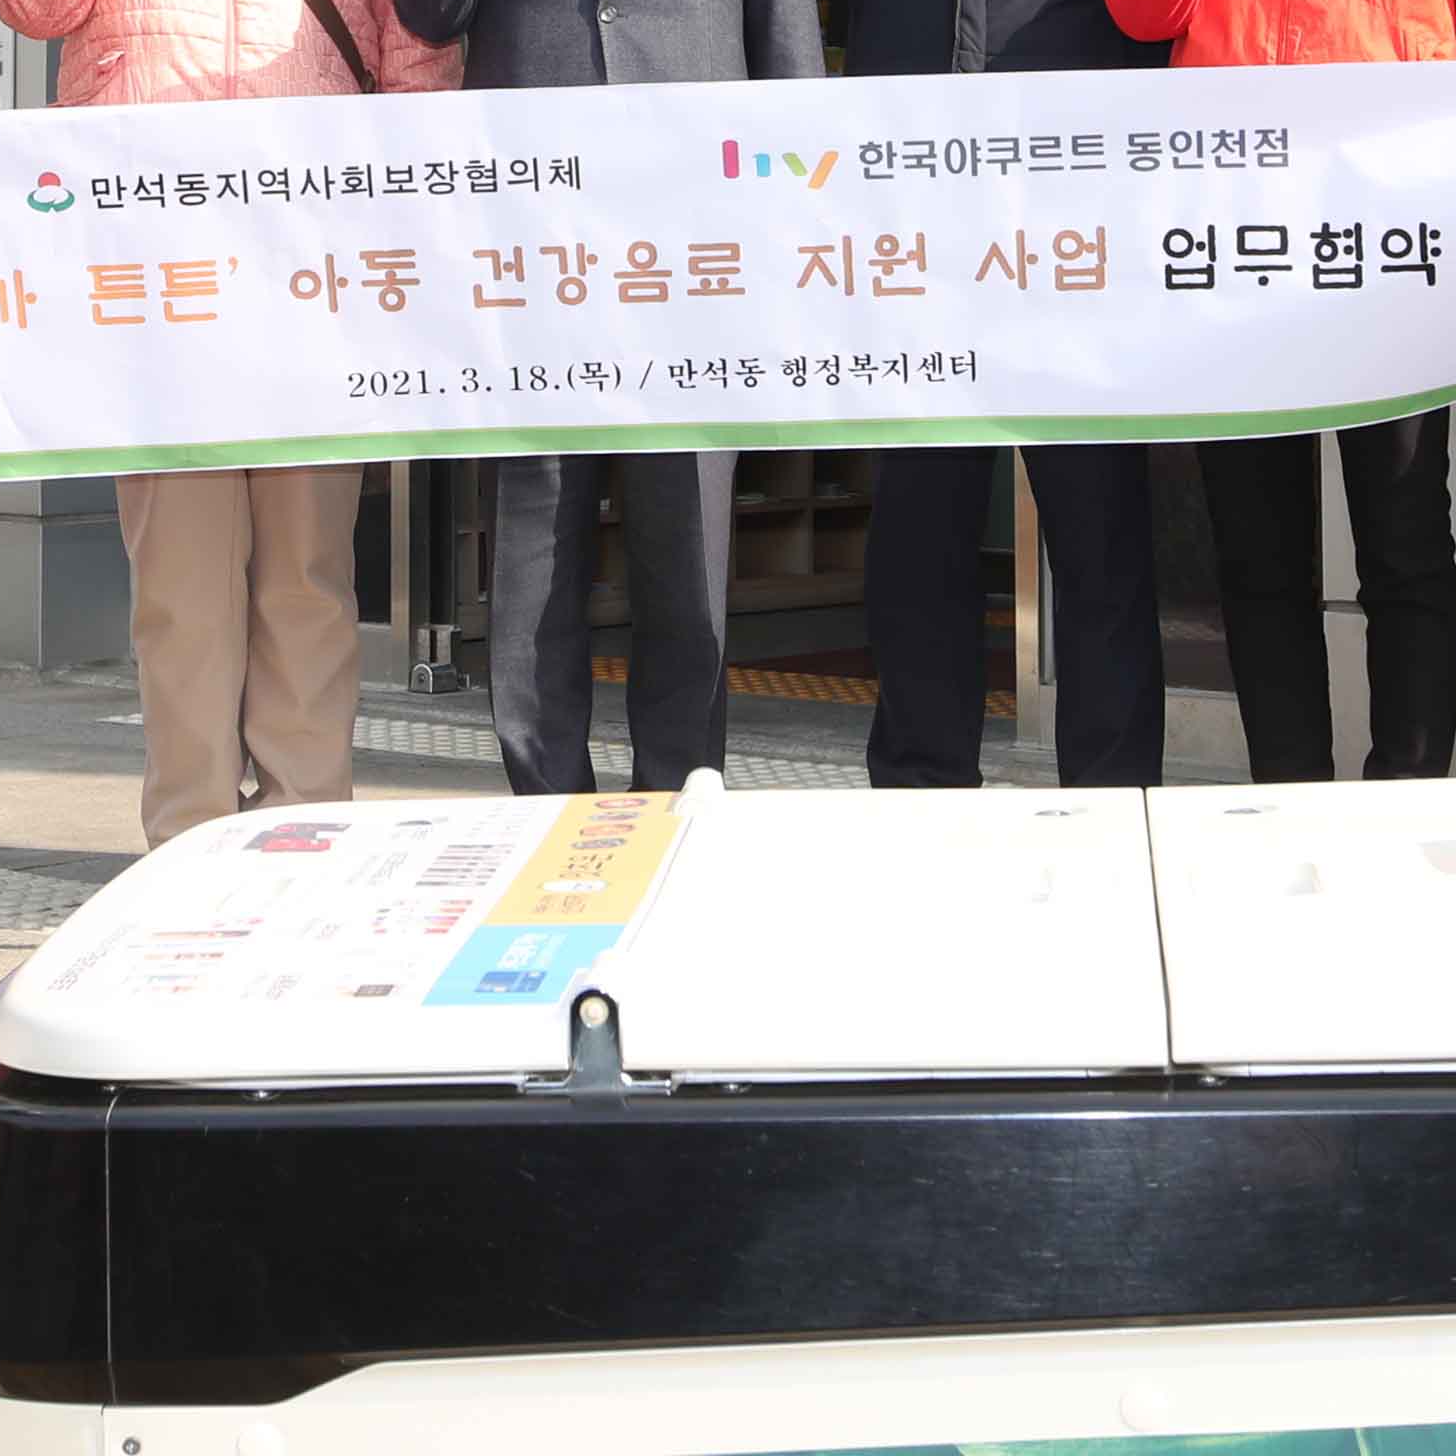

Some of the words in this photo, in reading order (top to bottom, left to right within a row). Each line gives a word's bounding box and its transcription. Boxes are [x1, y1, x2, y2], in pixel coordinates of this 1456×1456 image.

[858, 132, 1108, 180] 한국야쿠르트
[1126, 126, 1292, 172] 동인천점
[90, 155, 584, 209] 만석동지역사회보장협의체
[289, 248, 421, 313] 아동
[473, 237, 747, 308] 건강음료
[796, 231, 928, 297] 지원
[974, 226, 1109, 292] 사업
[348, 368, 446, 398] 2021.
[462, 366, 492, 393] 3.
[638, 361, 655, 389] /
[667, 357, 766, 389] 만석동
[781, 349, 979, 388] 행정복지센터
